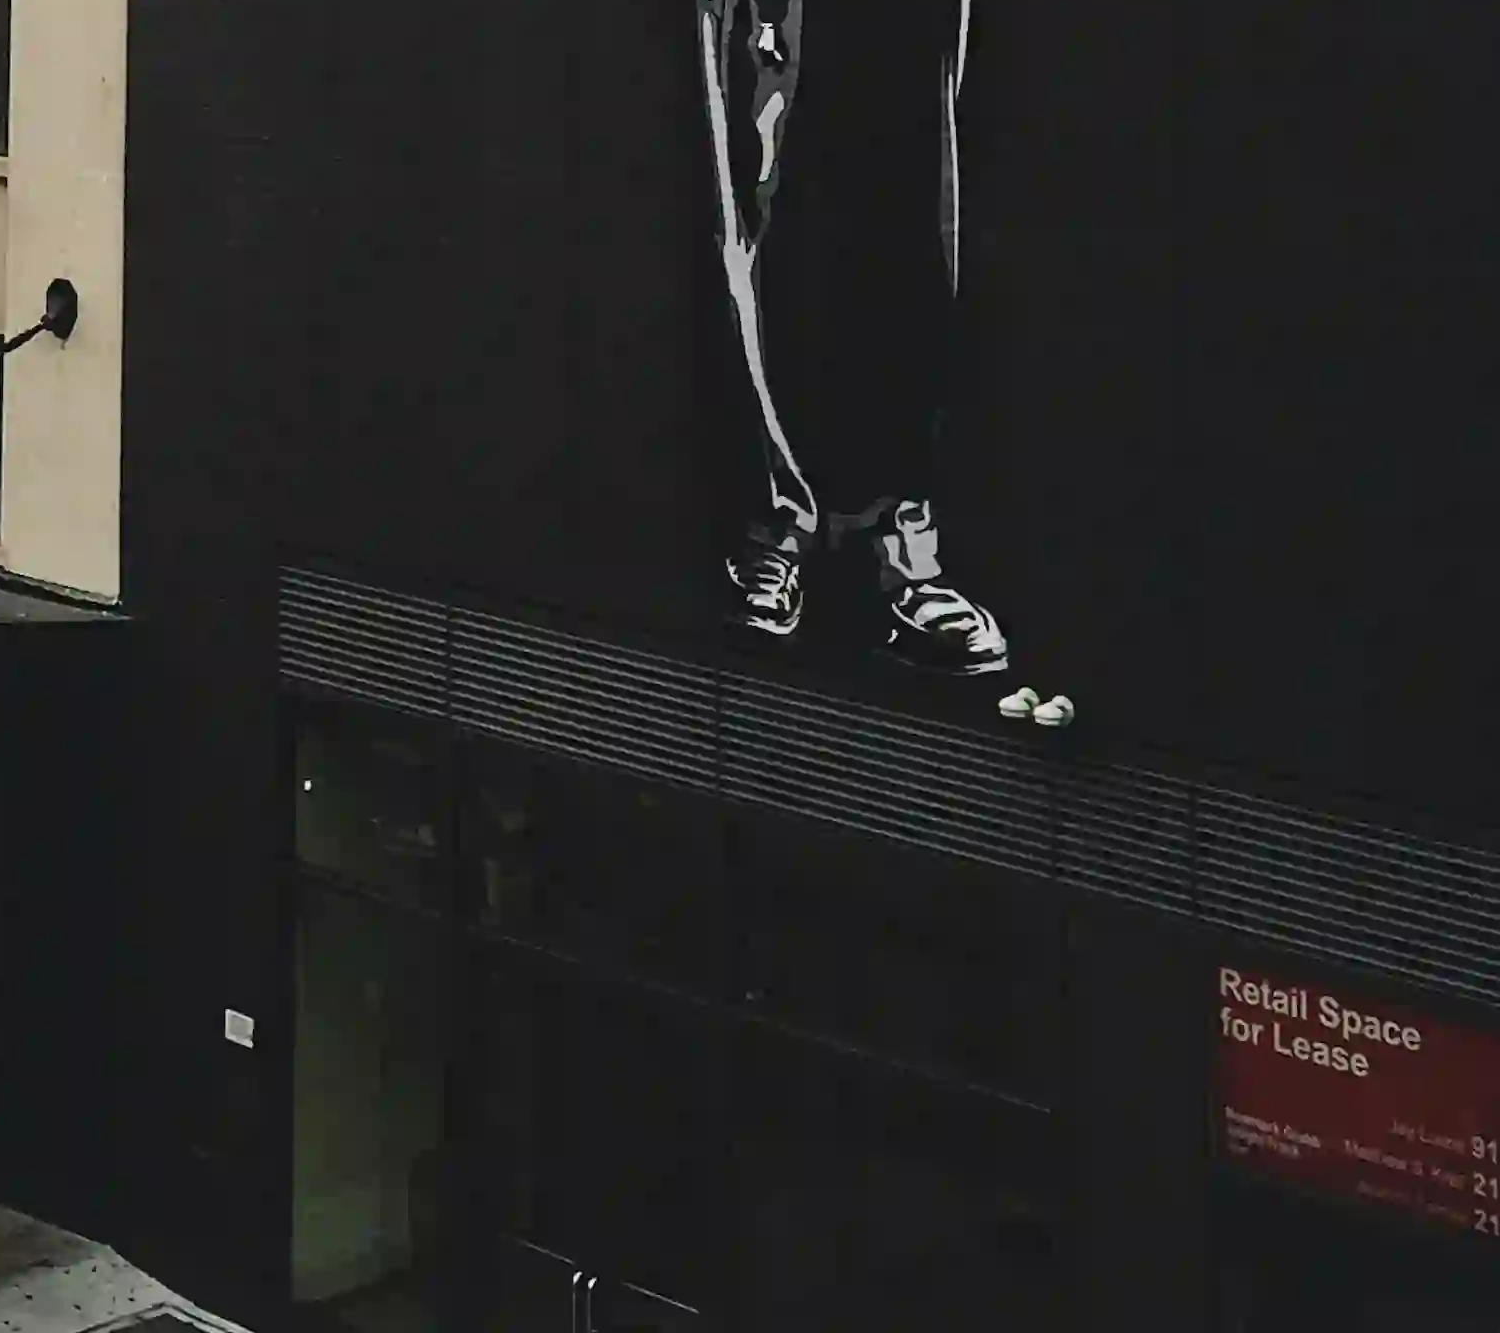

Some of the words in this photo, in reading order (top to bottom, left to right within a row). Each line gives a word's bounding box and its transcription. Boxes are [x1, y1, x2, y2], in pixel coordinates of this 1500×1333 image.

[1219, 967, 1308, 1020] Retail
[1319, 996, 1422, 1051] Space
[1220, 1007, 1264, 1046] for
[1273, 1021, 1369, 1077] Lease
